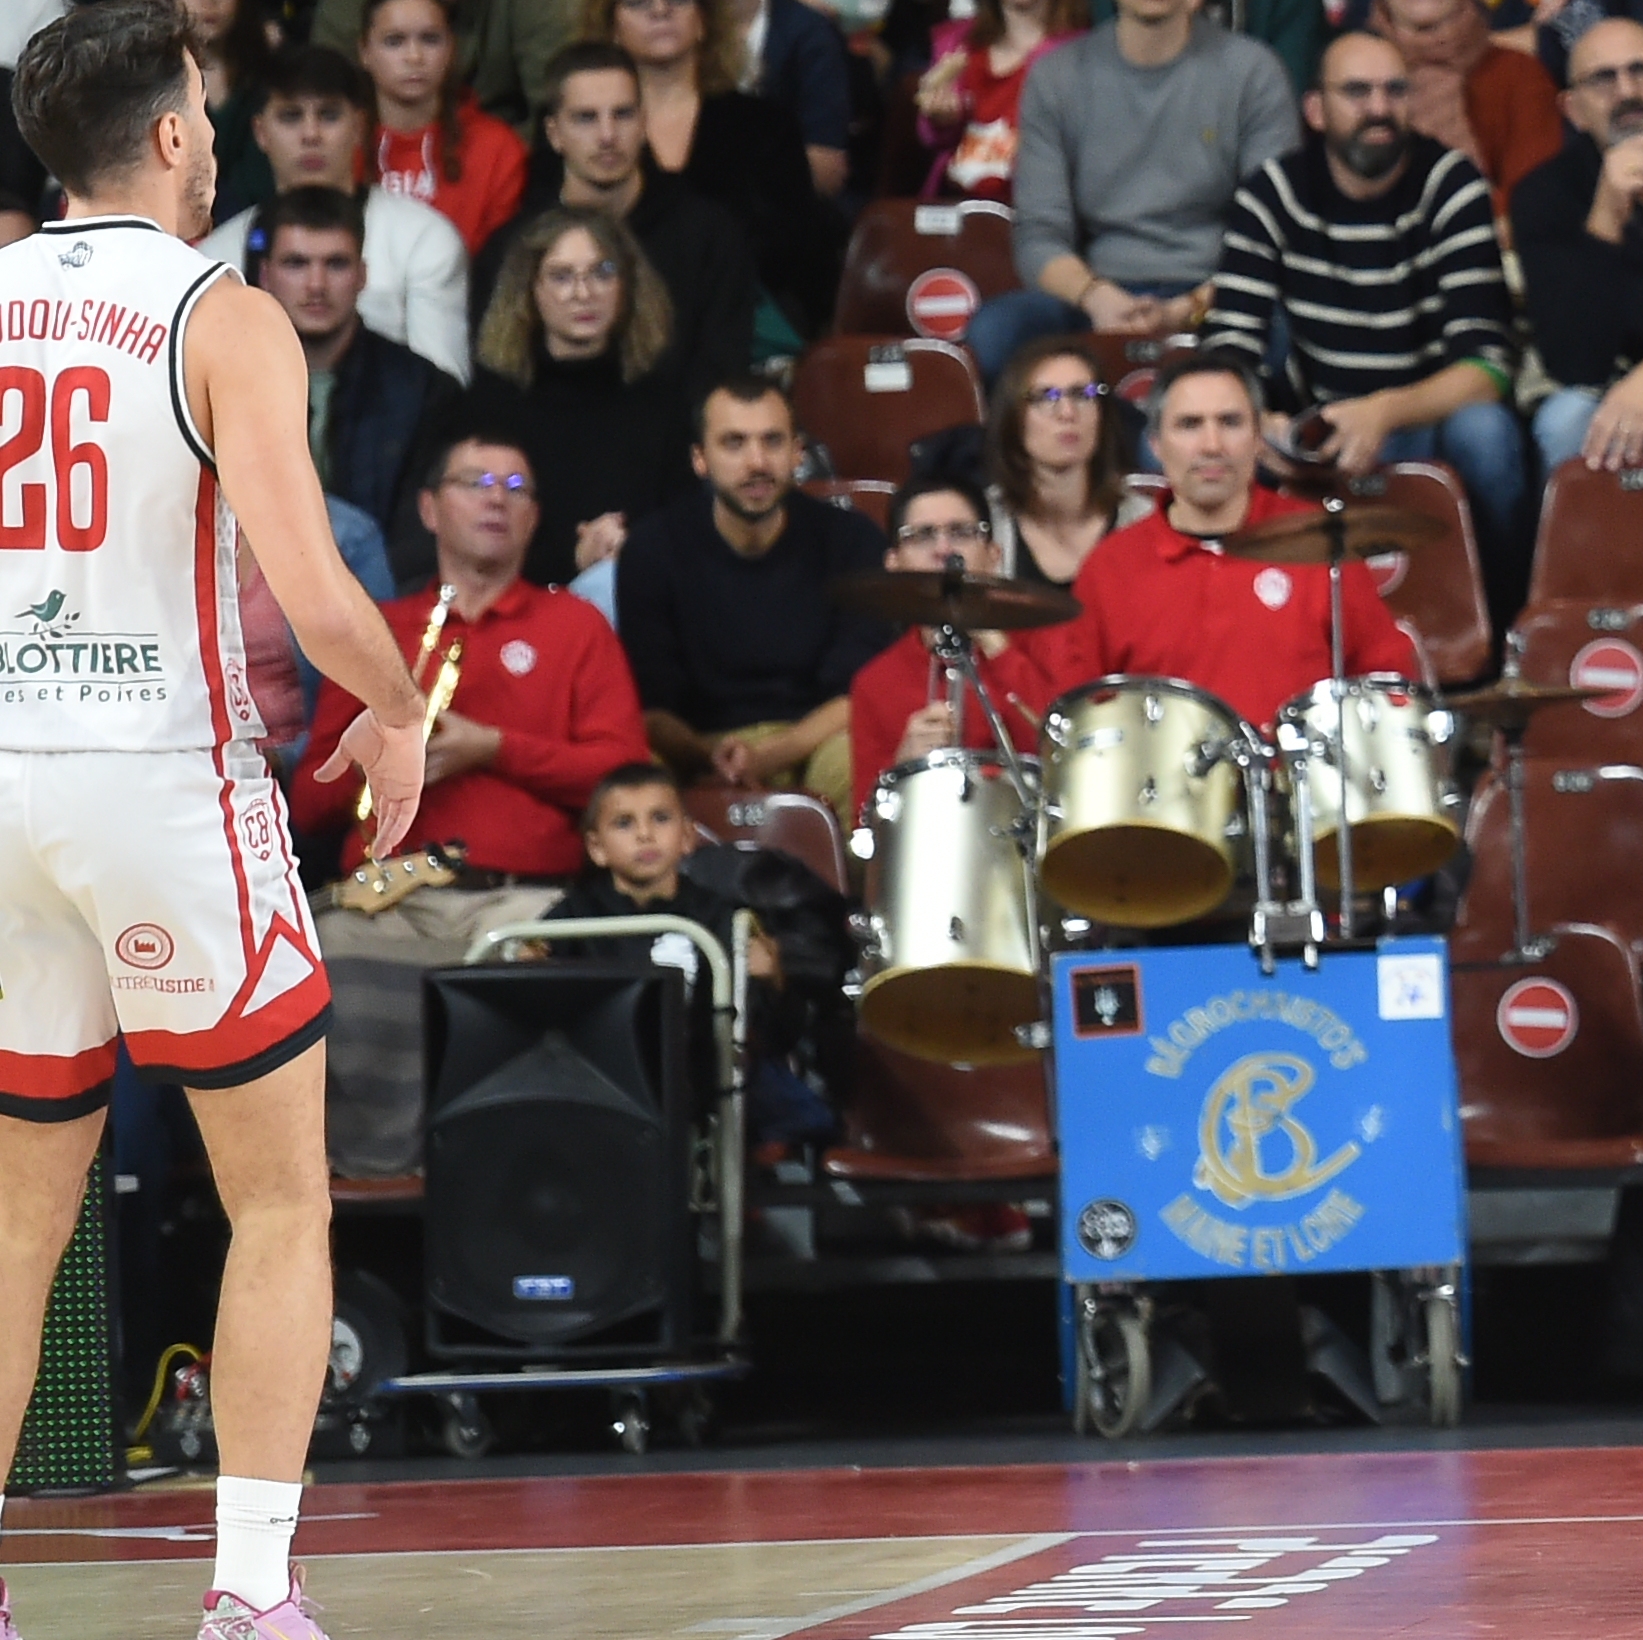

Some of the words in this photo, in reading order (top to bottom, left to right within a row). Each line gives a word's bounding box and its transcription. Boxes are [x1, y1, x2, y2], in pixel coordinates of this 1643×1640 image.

[0, 298, 168, 365] DOU-SINHA
[0, 365, 111, 553] 26
[0, 642, 163, 675] LOTTIERE
[37, 685, 65, 702] et
[79, 684, 168, 703] Poires
